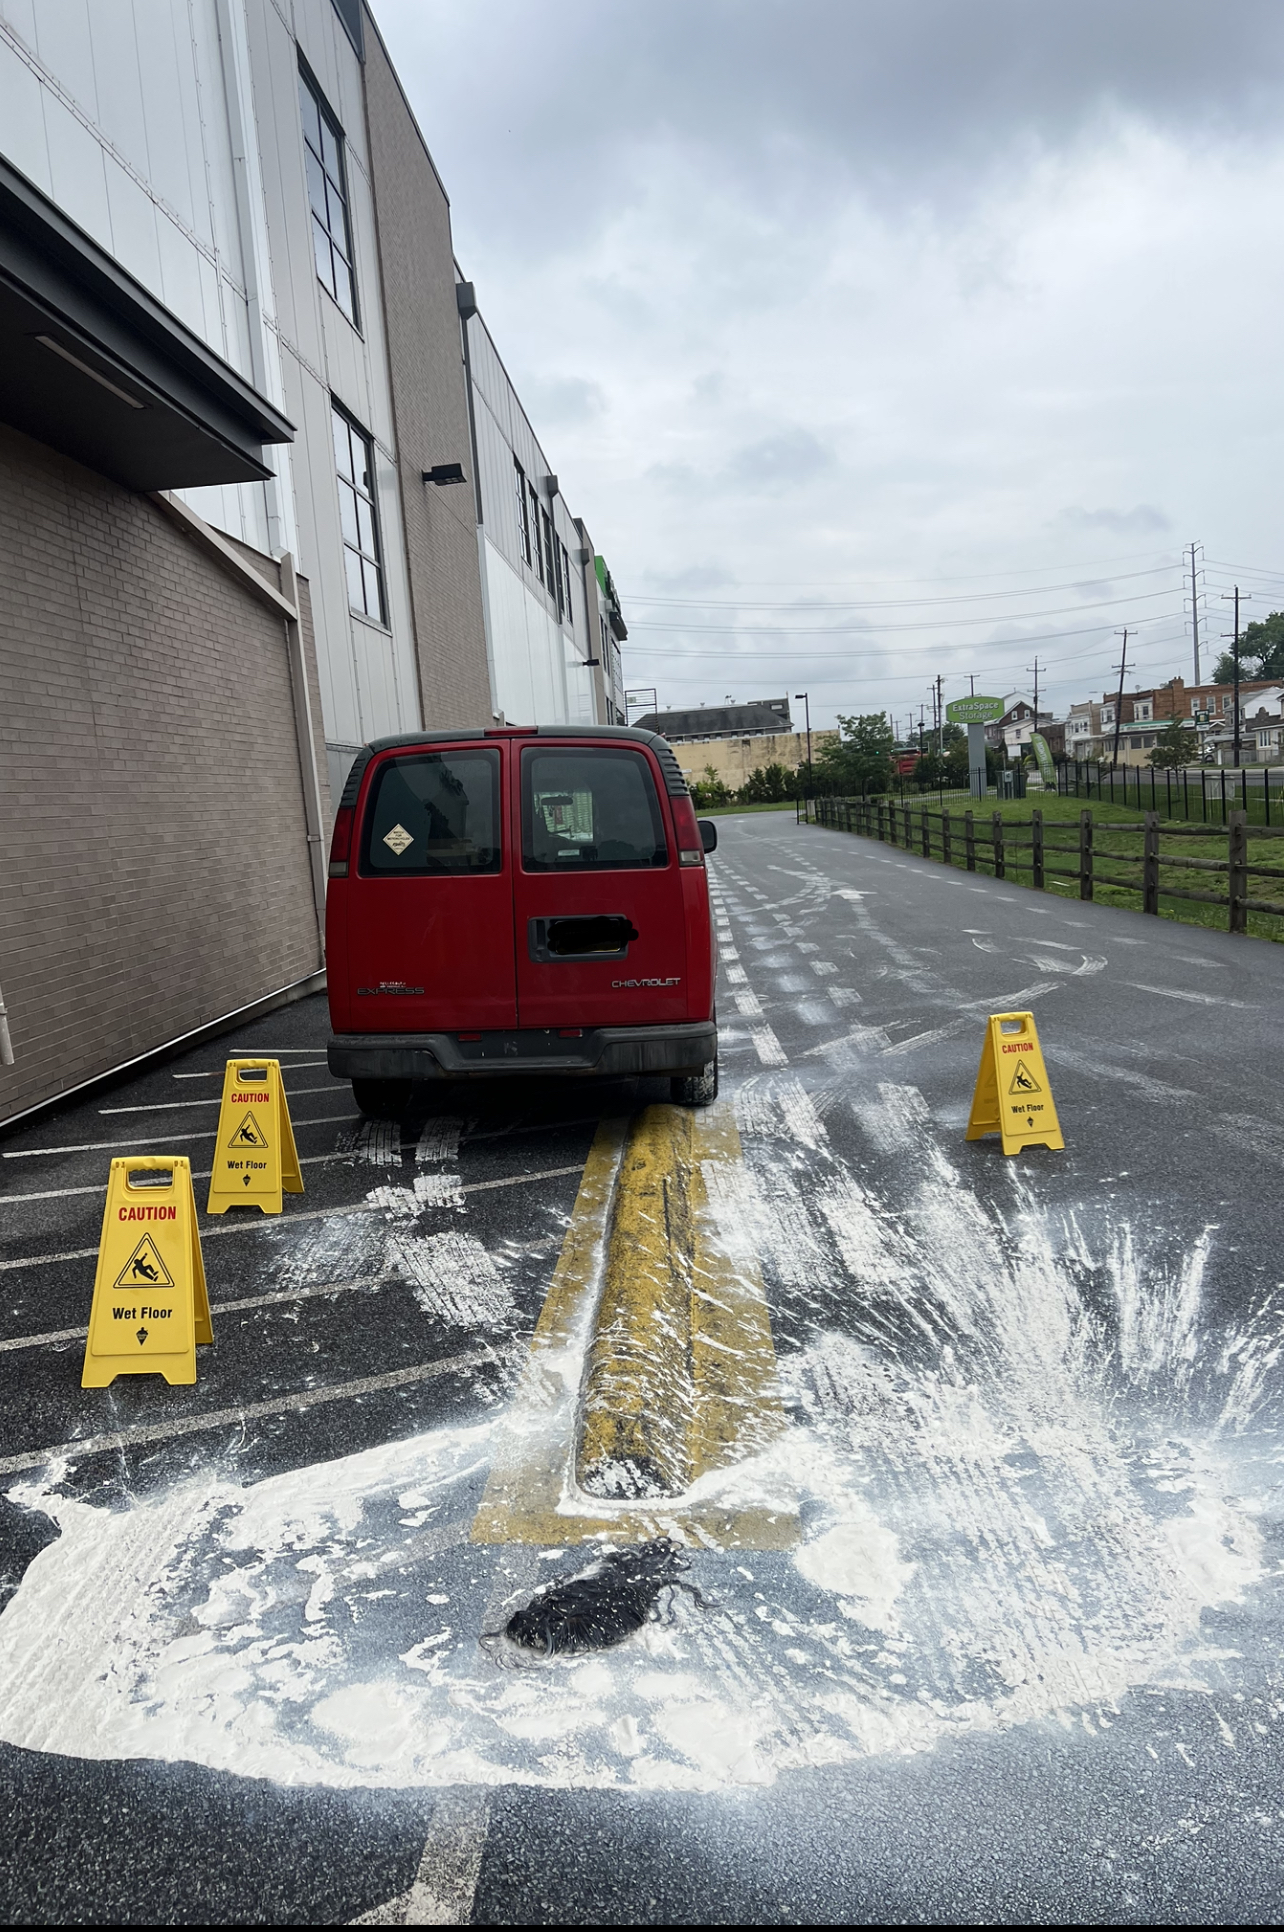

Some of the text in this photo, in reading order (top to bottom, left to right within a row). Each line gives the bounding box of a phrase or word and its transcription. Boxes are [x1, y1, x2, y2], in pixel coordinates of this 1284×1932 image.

[960, 711, 993, 720] Storage
[611, 977, 681, 988] CHEVROLET
[357, 986, 425, 995] EXPRESS
[1002, 1042, 1034, 1054] CAUTION
[231, 1092, 270, 1103] CAUTION
[1011, 1103, 1044, 1114] Wet Floor
[227, 1160, 267, 1169] Wet Floor
[118, 1205, 177, 1222] CAUTION
[112, 1306, 173, 1320] Wet Floor
